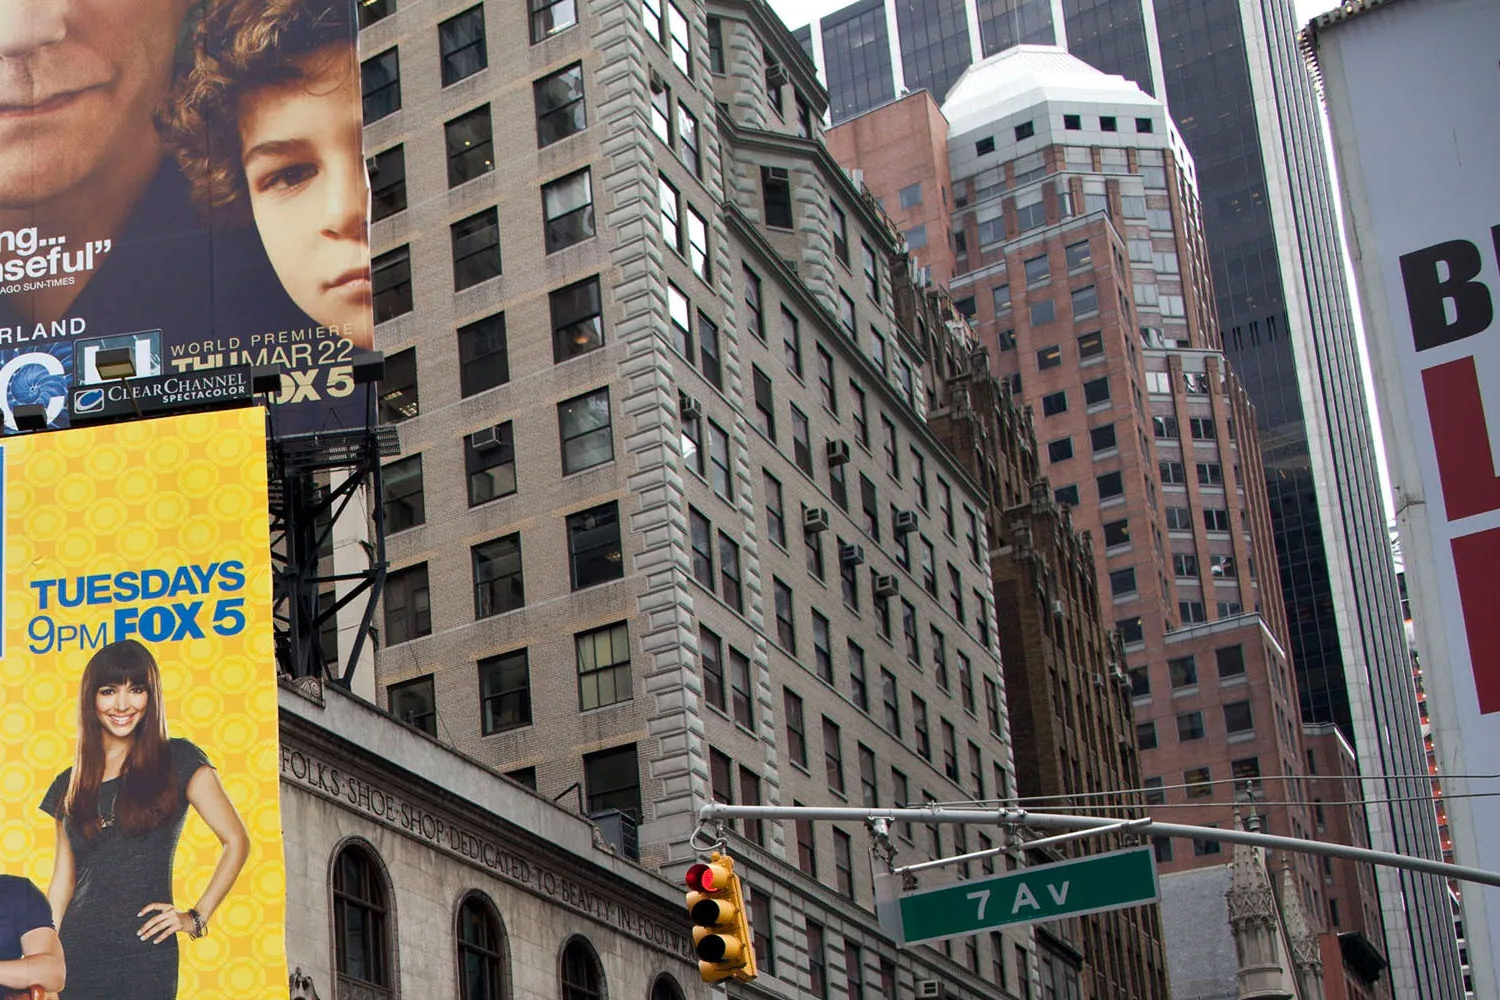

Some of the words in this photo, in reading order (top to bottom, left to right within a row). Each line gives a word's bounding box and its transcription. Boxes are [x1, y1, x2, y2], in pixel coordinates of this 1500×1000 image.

[22, 276, 76, 295] SUN-TIMES
[171, 337, 241, 357] WORLD
[251, 323, 354, 347] PREMIERE
[242, 343, 312, 369] MAR
[318, 338, 354, 365] 22
[163, 385, 246, 404] SPECTACOLOR
[253, 368, 321, 405] OX
[325, 365, 356, 398] 5
[30, 560, 245, 610] TUESDAYS
[29, 614, 108, 655] 9PM
[111, 605, 203, 643] FOX
[212, 597, 246, 637] 5
[281, 748, 340, 797] FOLKS
[347, 777, 395, 822] SHOE
[401, 803, 444, 844] SHOP
[449, 825, 531, 883] DEDICATED
[534, 866, 556, 896] TO
[616, 904, 631, 930] IN
[966, 889, 991, 921] 7
[1011, 880, 1070, 914] Av
